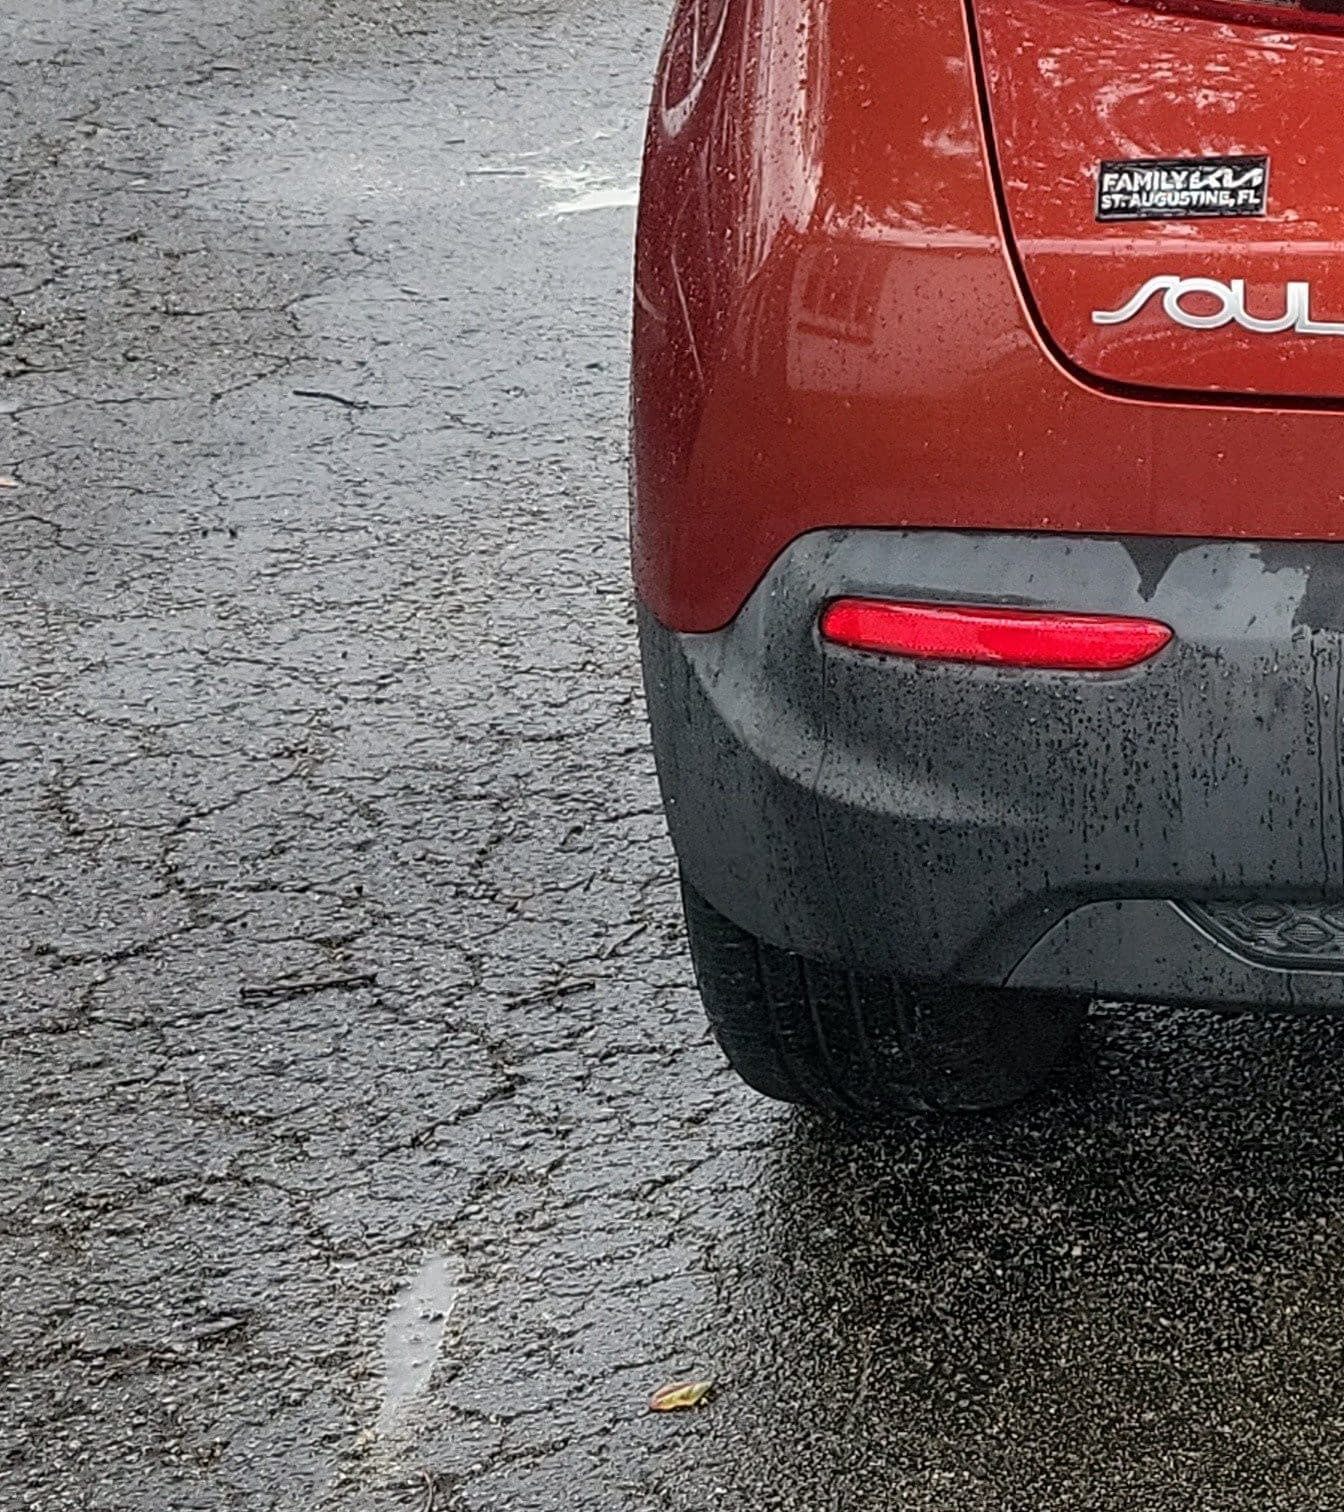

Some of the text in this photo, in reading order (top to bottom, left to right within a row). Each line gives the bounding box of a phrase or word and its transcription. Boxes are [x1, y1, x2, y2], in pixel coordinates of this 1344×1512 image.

[1102, 169, 1188, 192] FAMILY
[1101, 189, 1261, 210] ST. AUGUSTINE, FL
